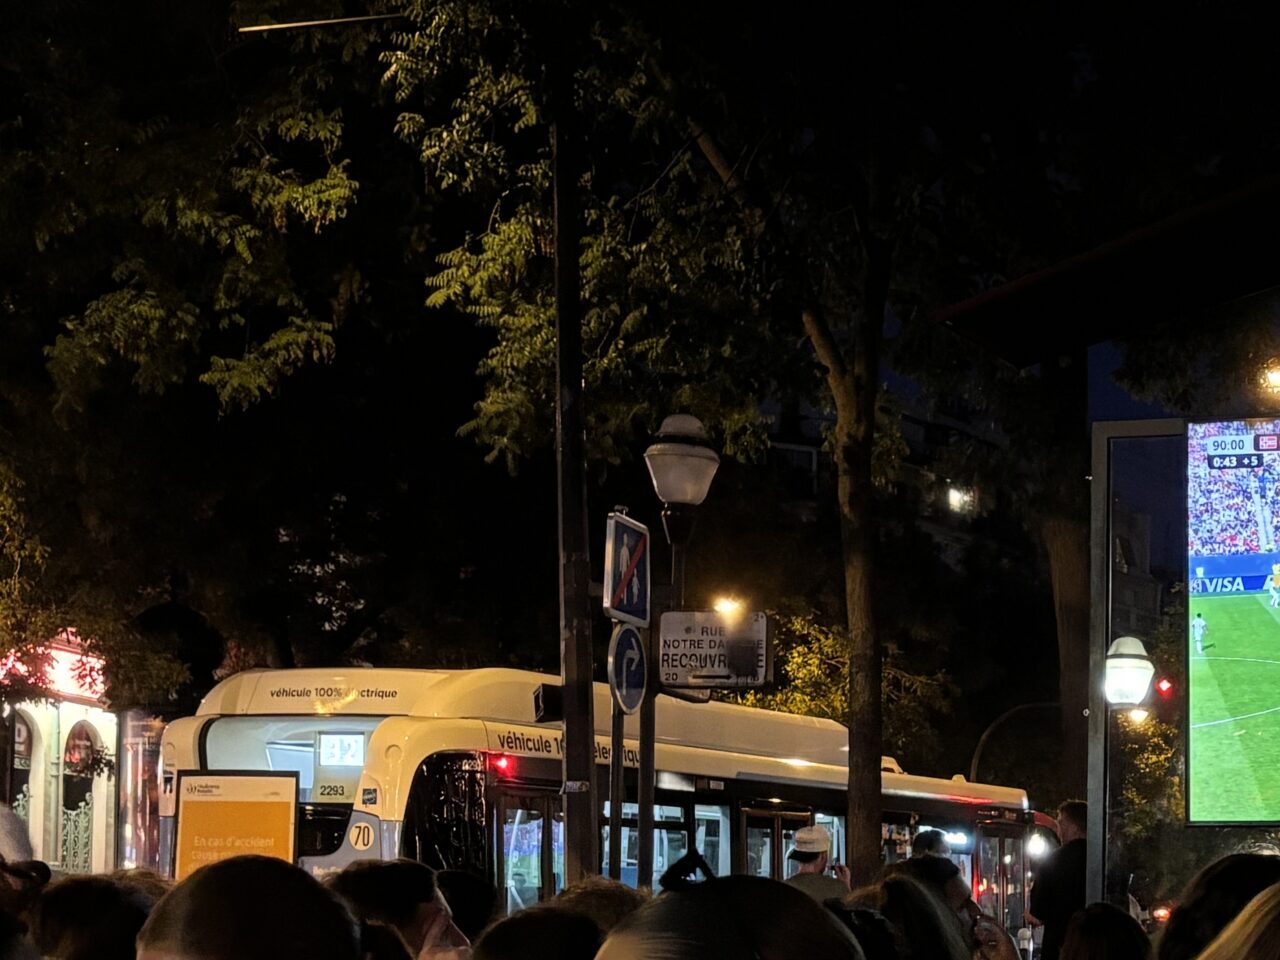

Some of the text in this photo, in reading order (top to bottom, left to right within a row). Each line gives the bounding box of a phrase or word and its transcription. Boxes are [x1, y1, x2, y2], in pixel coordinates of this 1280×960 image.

[1213, 440, 1245, 451] 90:00
[1213, 456, 1258, 468] 0:43 +5
[1203, 576, 1245, 592] VISA
[701, 626, 726, 637] RUE
[663, 639, 705, 650] NOTRE
[662, 653, 764, 669] RECOUVRE
[665, 672, 678, 681] 20
[270, 687, 398, 700] véhicule 100% ctrique
[498, 731, 552, 753] véhicule
[319, 785, 345, 797] 2293
[354, 825, 370, 847] 70
